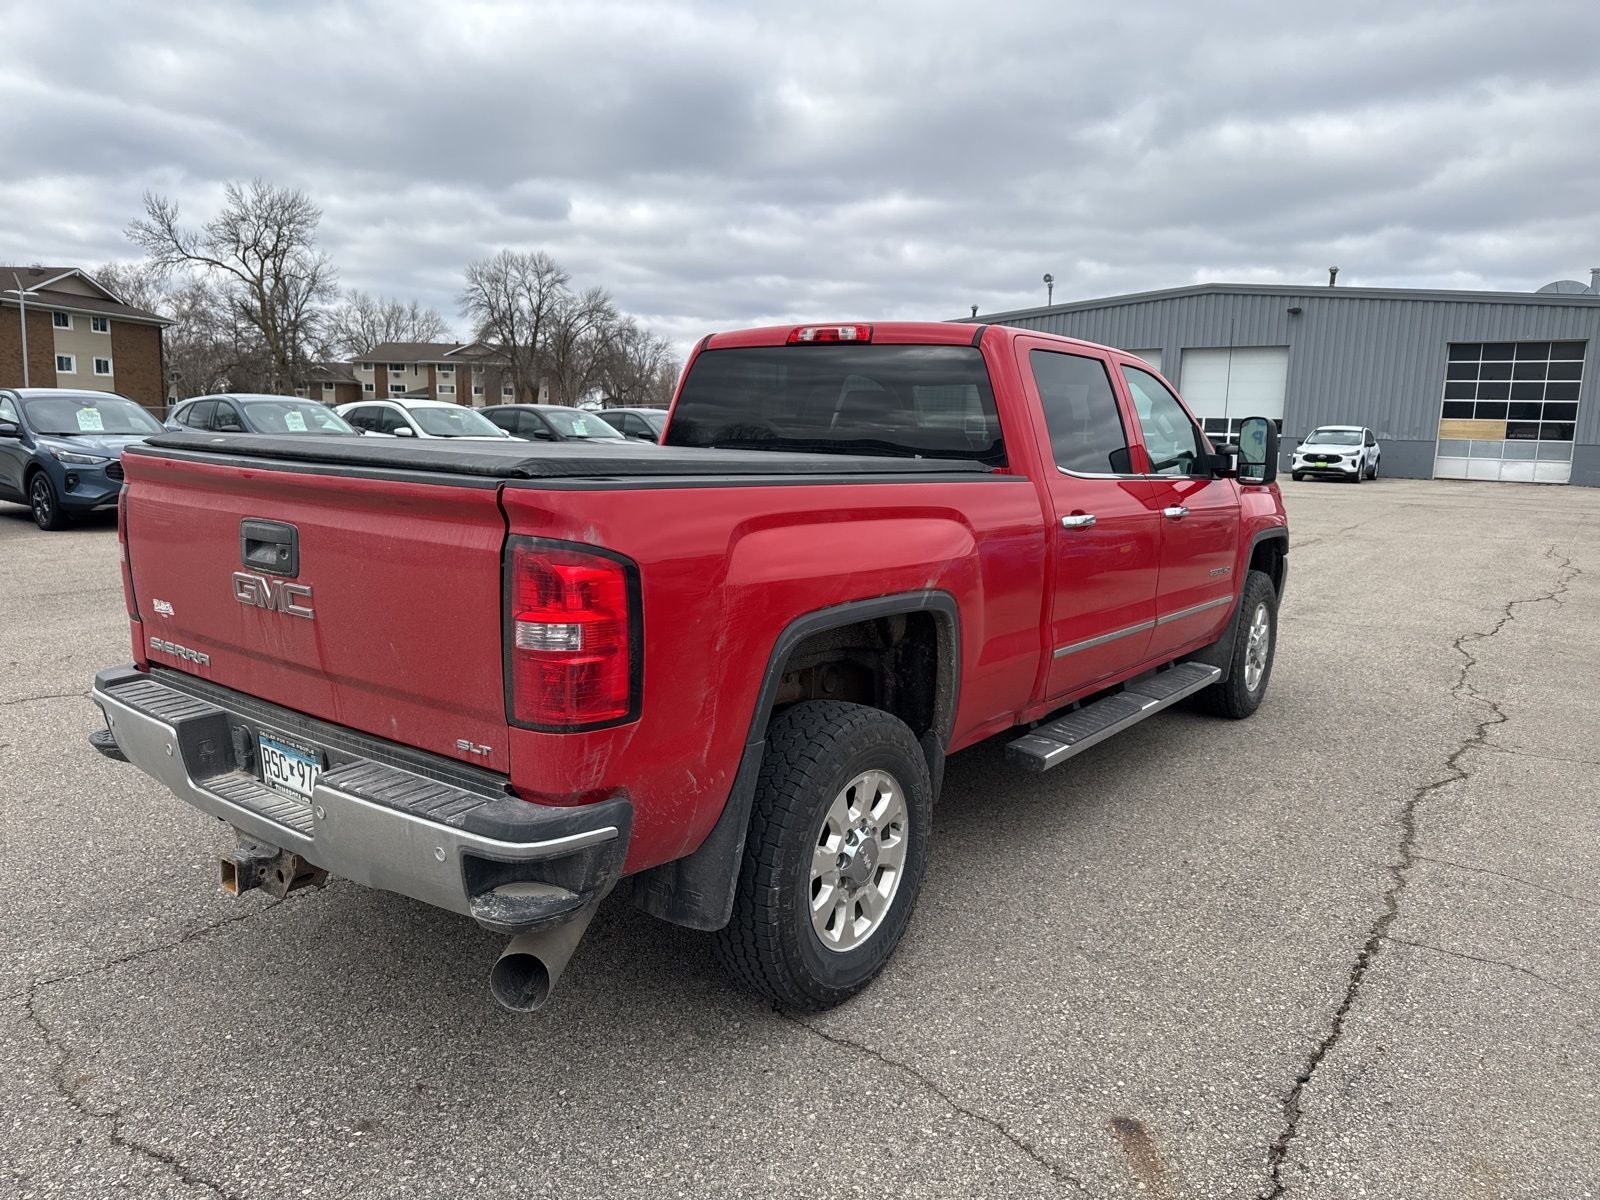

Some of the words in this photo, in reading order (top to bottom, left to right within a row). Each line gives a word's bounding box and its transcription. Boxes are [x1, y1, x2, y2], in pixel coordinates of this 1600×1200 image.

[232, 571, 315, 619] GMC
[150, 636, 211, 668] SIERRA
[262, 746, 289, 782] RSC
[456, 738, 492, 756] SLT
